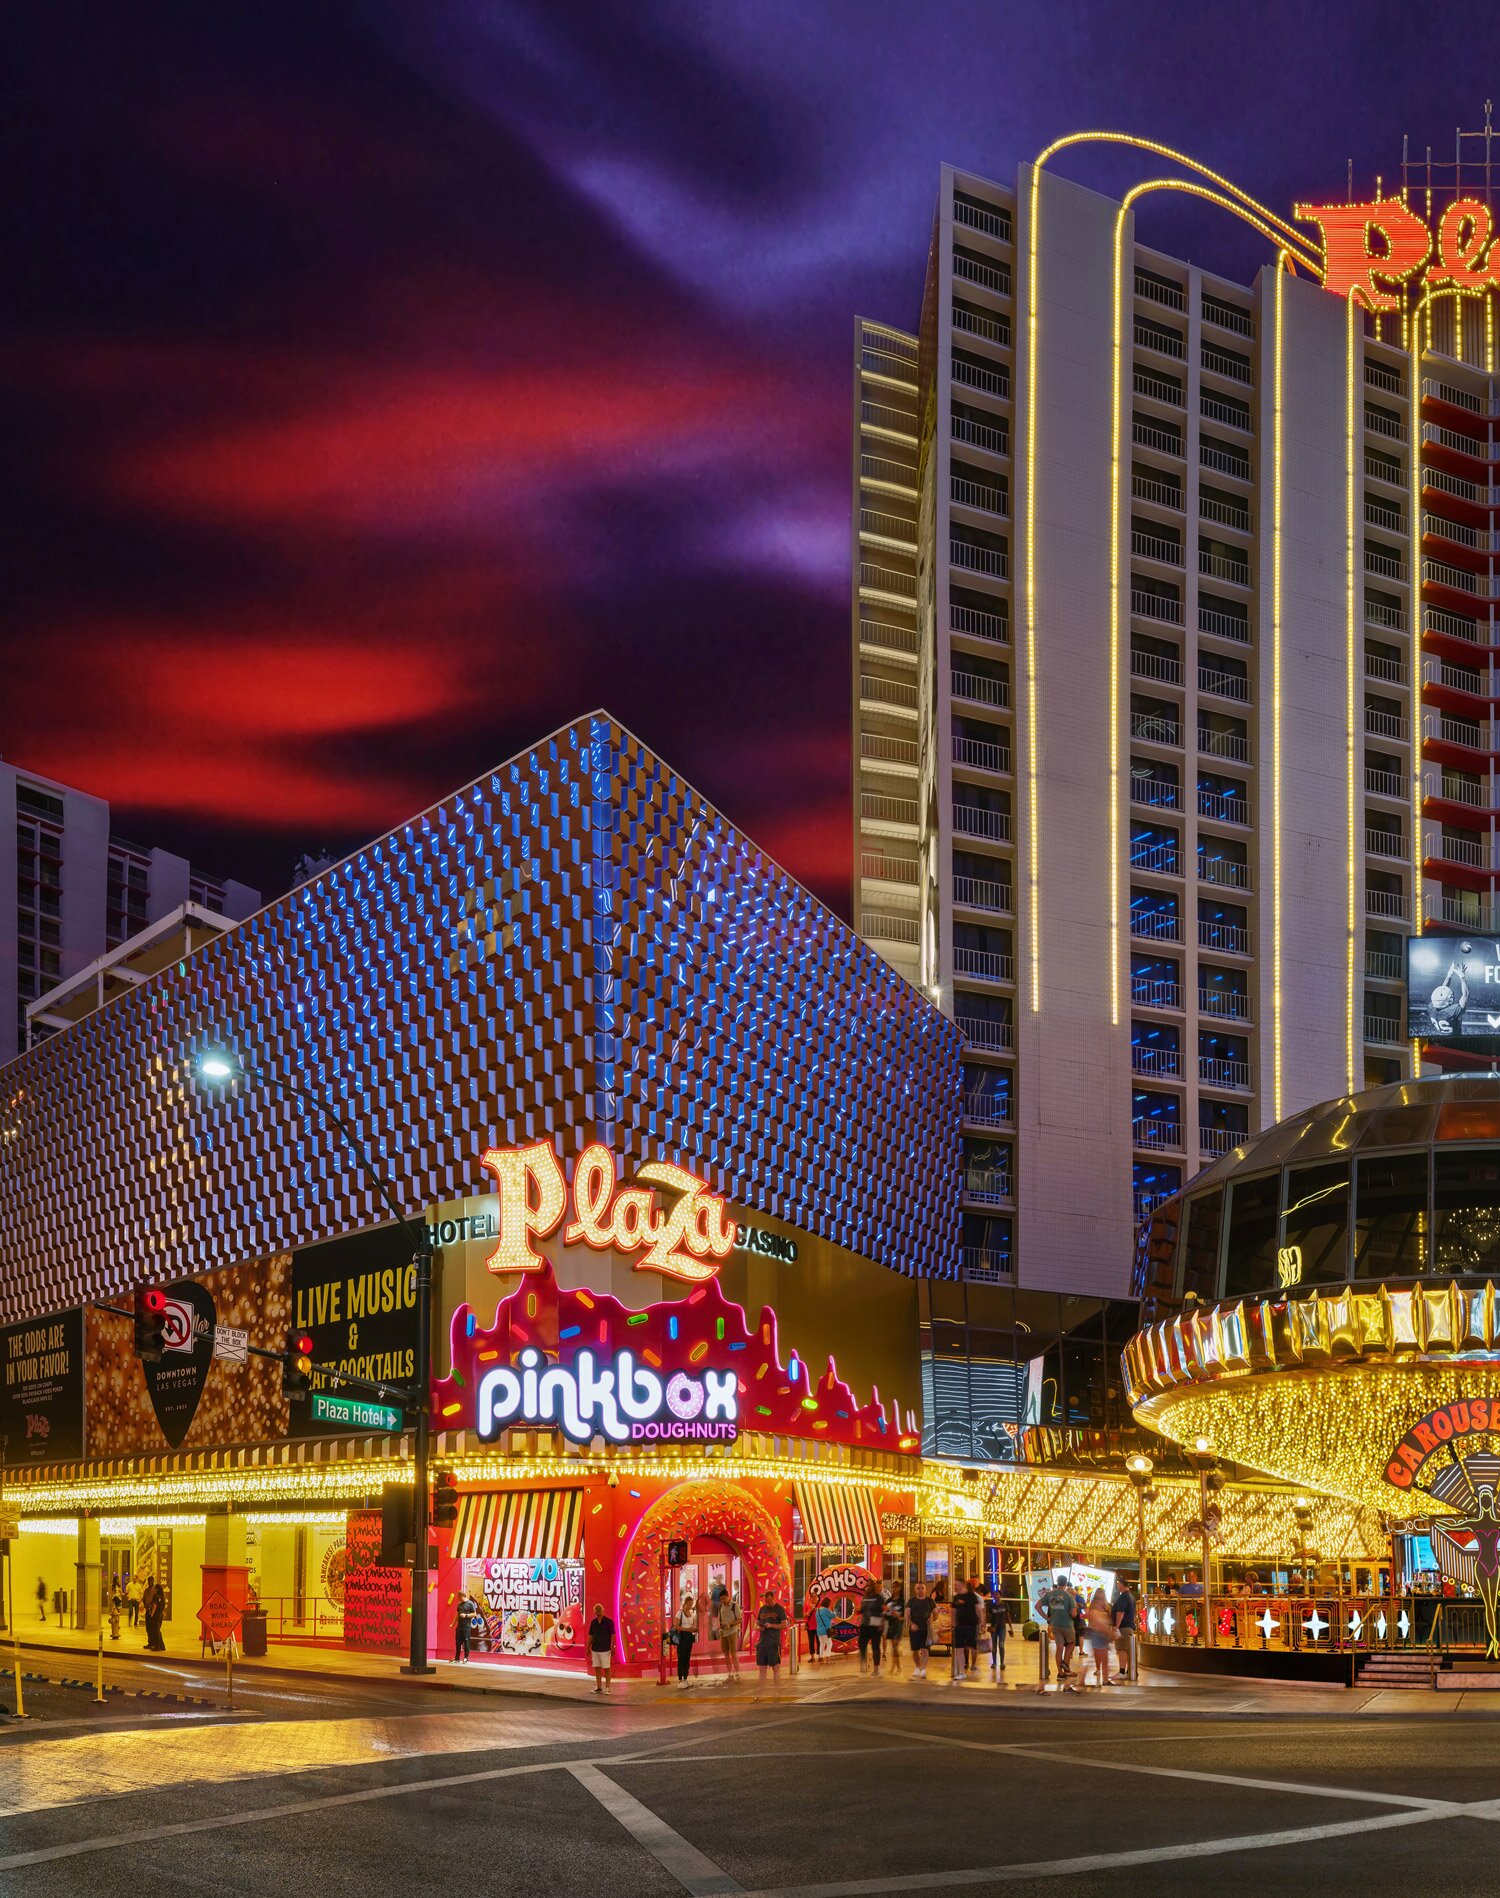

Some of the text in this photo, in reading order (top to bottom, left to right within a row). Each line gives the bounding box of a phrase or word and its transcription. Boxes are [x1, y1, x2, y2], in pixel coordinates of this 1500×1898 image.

[481, 1141, 736, 1281] Plaza
[426, 1214, 500, 1246] HOTEL
[734, 1223, 798, 1262] CASINO
[297, 1264, 417, 1329] LIVE MUSIC
[8, 1323, 65, 1358] THE ODDS ARE
[216, 1327, 246, 1339] DON'T BLOCK
[221, 1336, 242, 1346] THE BOX
[348, 1322, 359, 1350] &
[6, 1350, 69, 1385] IN YOUR FAVOR!
[156, 1366, 197, 1381] DOWNTOWN
[340, 1349, 415, 1386] COCKTAILS
[156, 1377, 197, 1392] LAS VEGAS
[478, 1349, 738, 1440] pinkbox
[317, 1399, 383, 1426] Plaza Hotel
[632, 1422, 737, 1439] DOUGHNUTS
[490, 1559, 558, 1581] OVER 70
[810, 1568, 867, 1596] pinkbo
[484, 1579, 564, 1597] DOUGHNUT
[487, 1594, 560, 1613] VARIETIES
[211, 1621, 233, 1629] AHEAD
